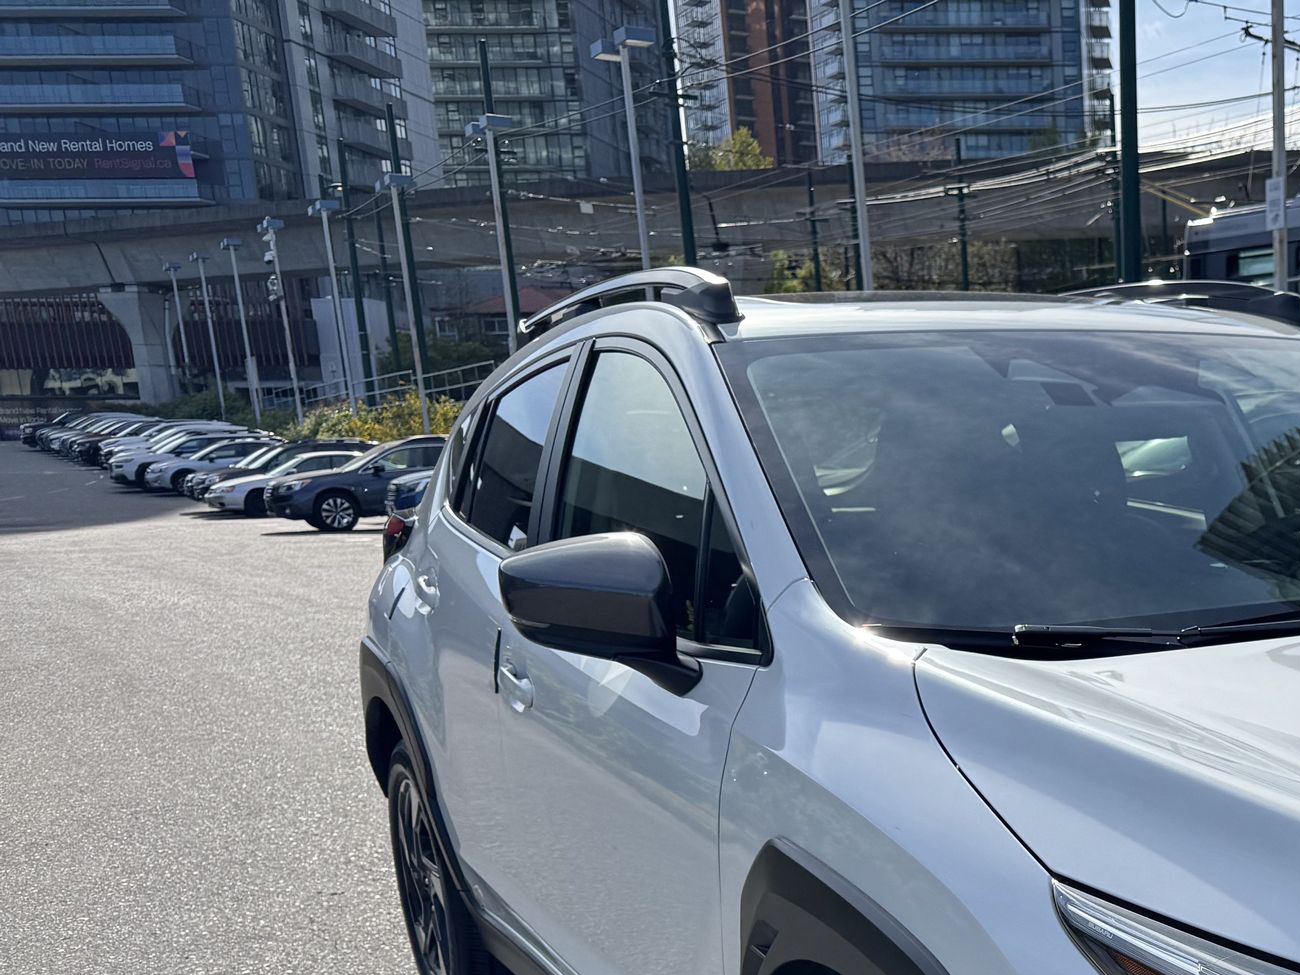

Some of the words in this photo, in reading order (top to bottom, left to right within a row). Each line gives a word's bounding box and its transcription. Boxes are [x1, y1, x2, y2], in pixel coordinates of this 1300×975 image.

[28, 139, 58, 152] New
[61, 138, 103, 152] Rental
[106, 138, 154, 152] Homes
[48, 158, 88, 170] TODAY
[94, 156, 172, 170] RentSignal.ca
